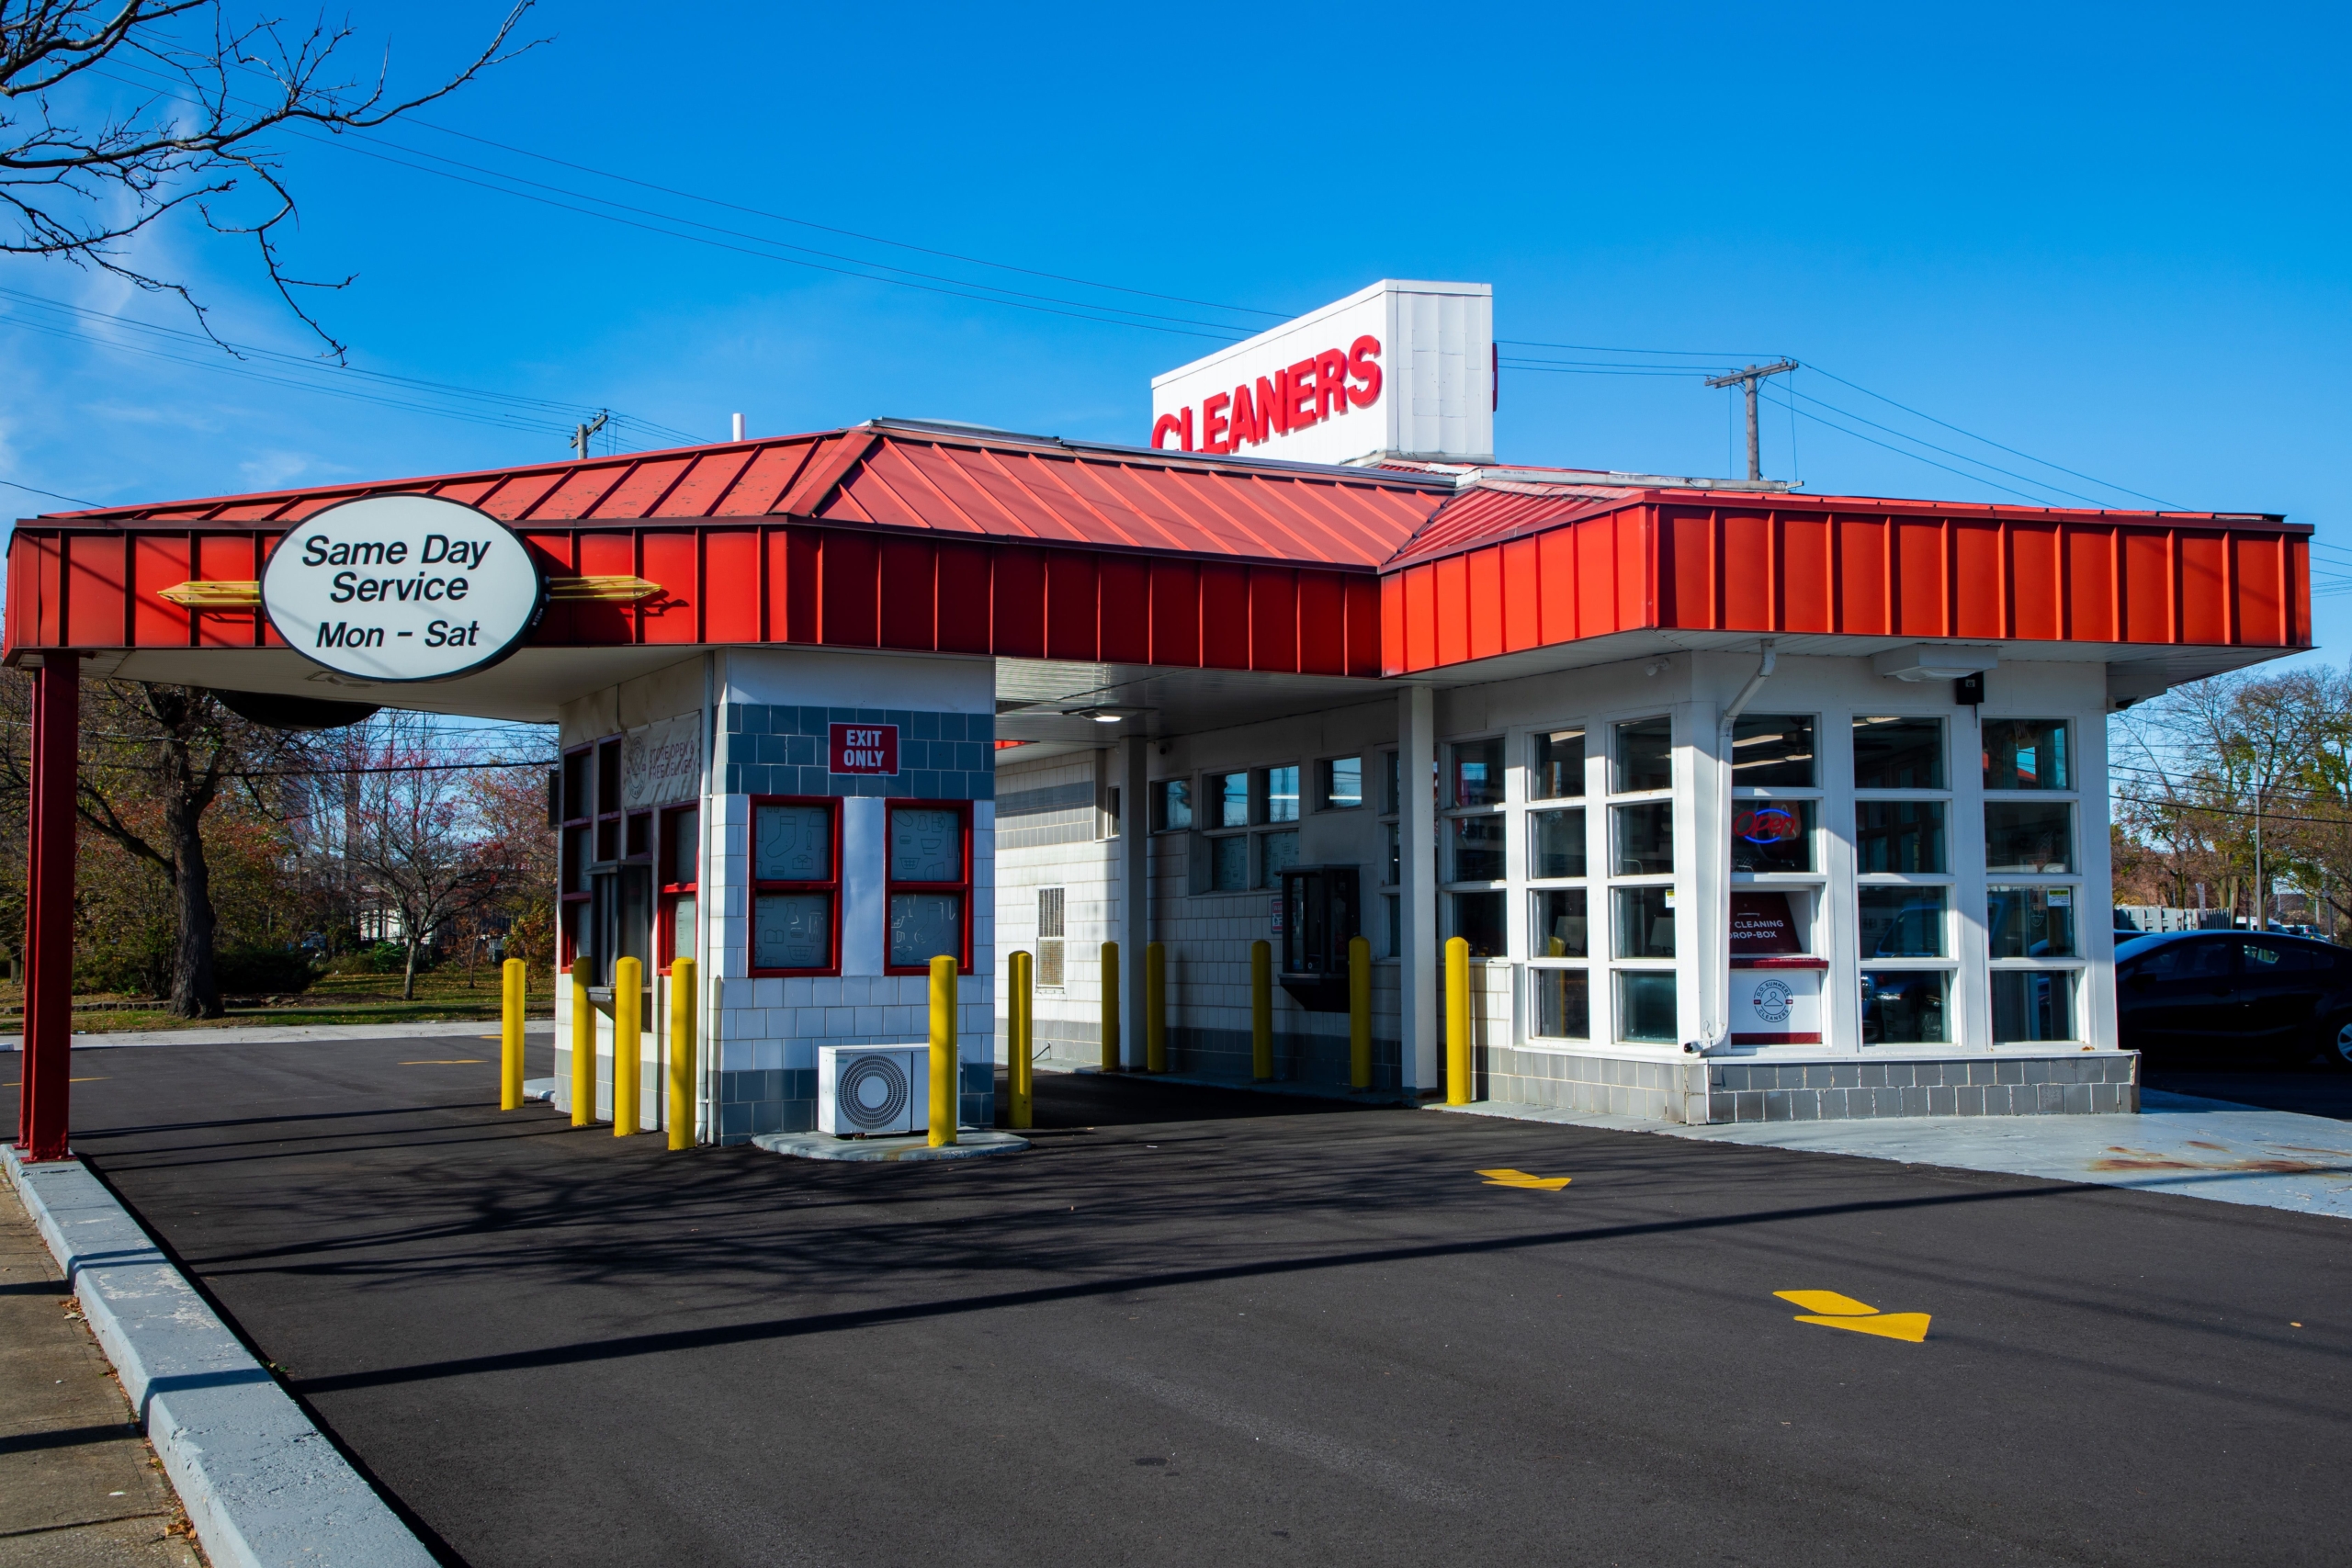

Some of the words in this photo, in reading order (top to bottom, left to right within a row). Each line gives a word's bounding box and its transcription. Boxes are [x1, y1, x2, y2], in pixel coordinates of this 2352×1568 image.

[1151, 334, 1382, 455] CLEANERS
[302, 535, 408, 567] Same
[421, 534, 492, 570] Day
[330, 571, 469, 603] Service
[316, 622, 385, 648] Mon
[424, 620, 480, 648] Sat
[846, 729, 882, 747] EXIT
[650, 746, 669, 763] STORE
[671, 742, 688, 758] OPEN
[690, 739, 695, 754] &
[843, 749, 885, 767] ONLY
[649, 762, 665, 780] FREE
[665, 757, 697, 778] DELIVERY
[1734, 811, 1796, 838] Open
[1734, 920, 1784, 929] CLEANING
[1765, 982, 1791, 997] SUMMERS
[1758, 1009, 1790, 1021] CLEANERS
